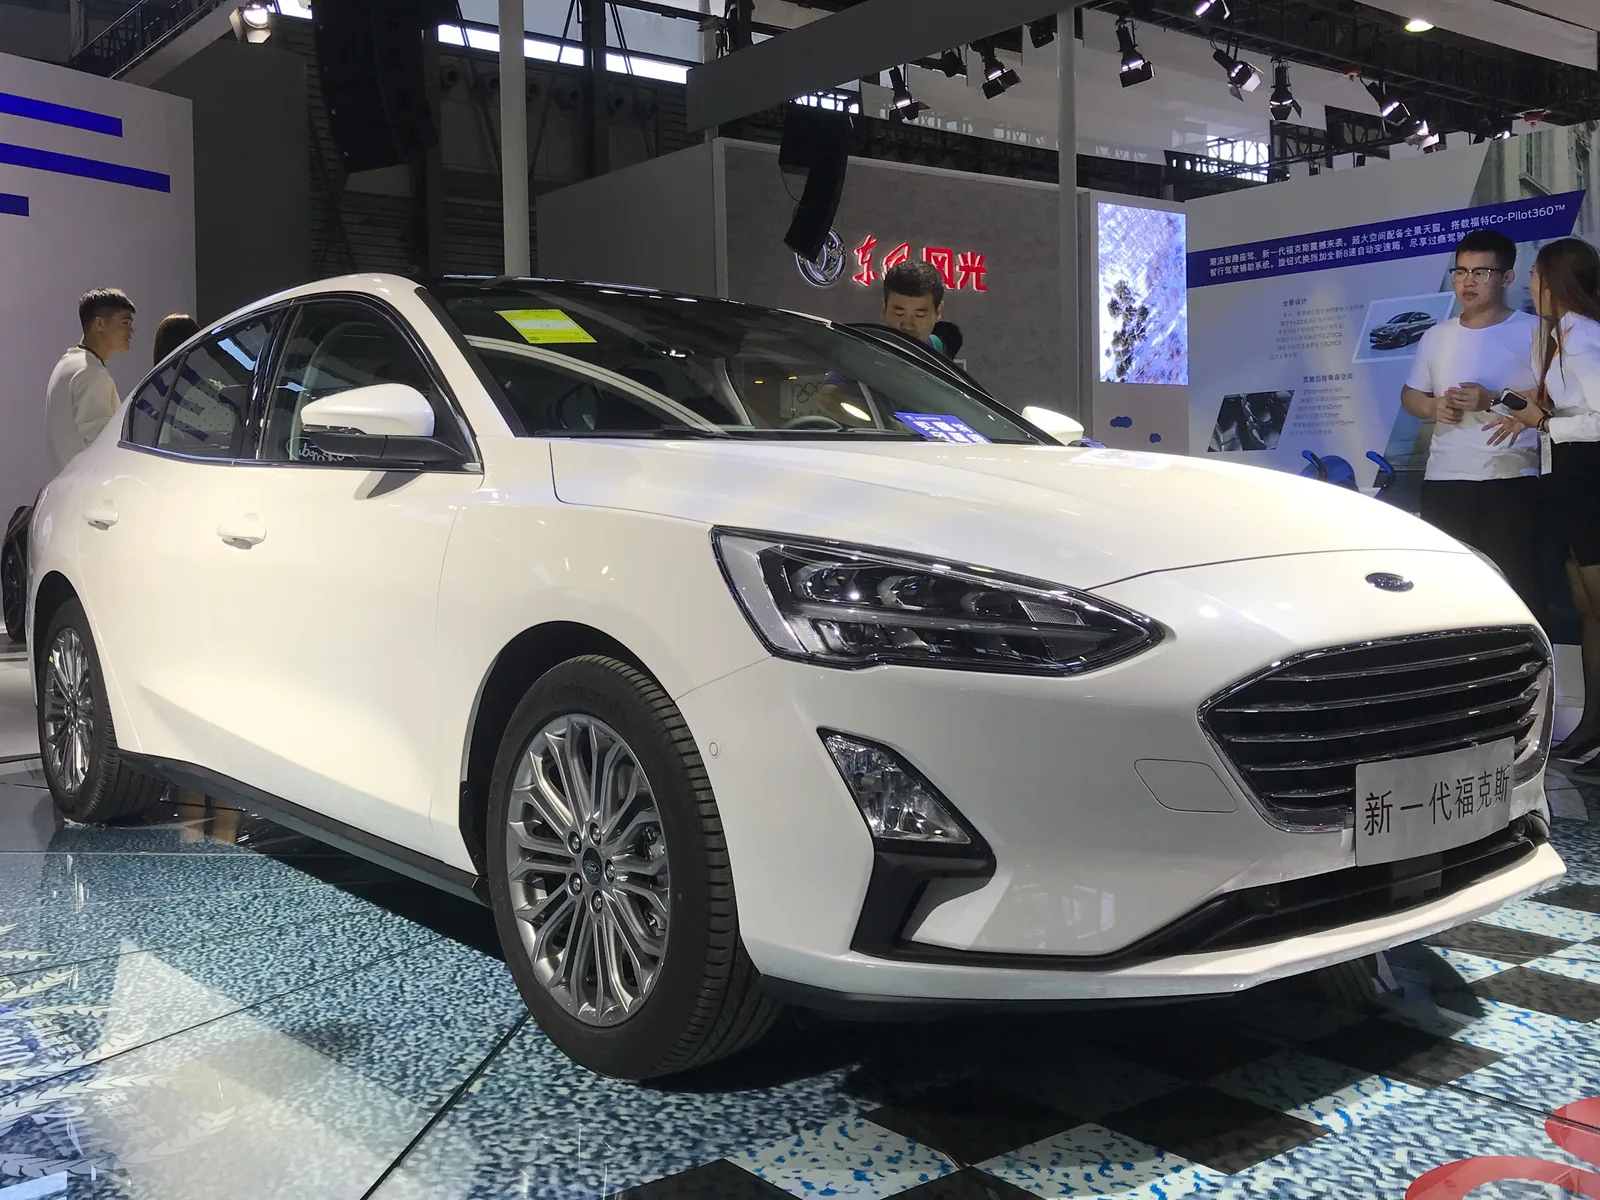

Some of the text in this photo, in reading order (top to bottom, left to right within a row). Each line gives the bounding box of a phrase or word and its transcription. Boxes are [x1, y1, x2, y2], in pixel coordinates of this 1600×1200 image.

[1364, 764, 1510, 836] 新一代福克斯
